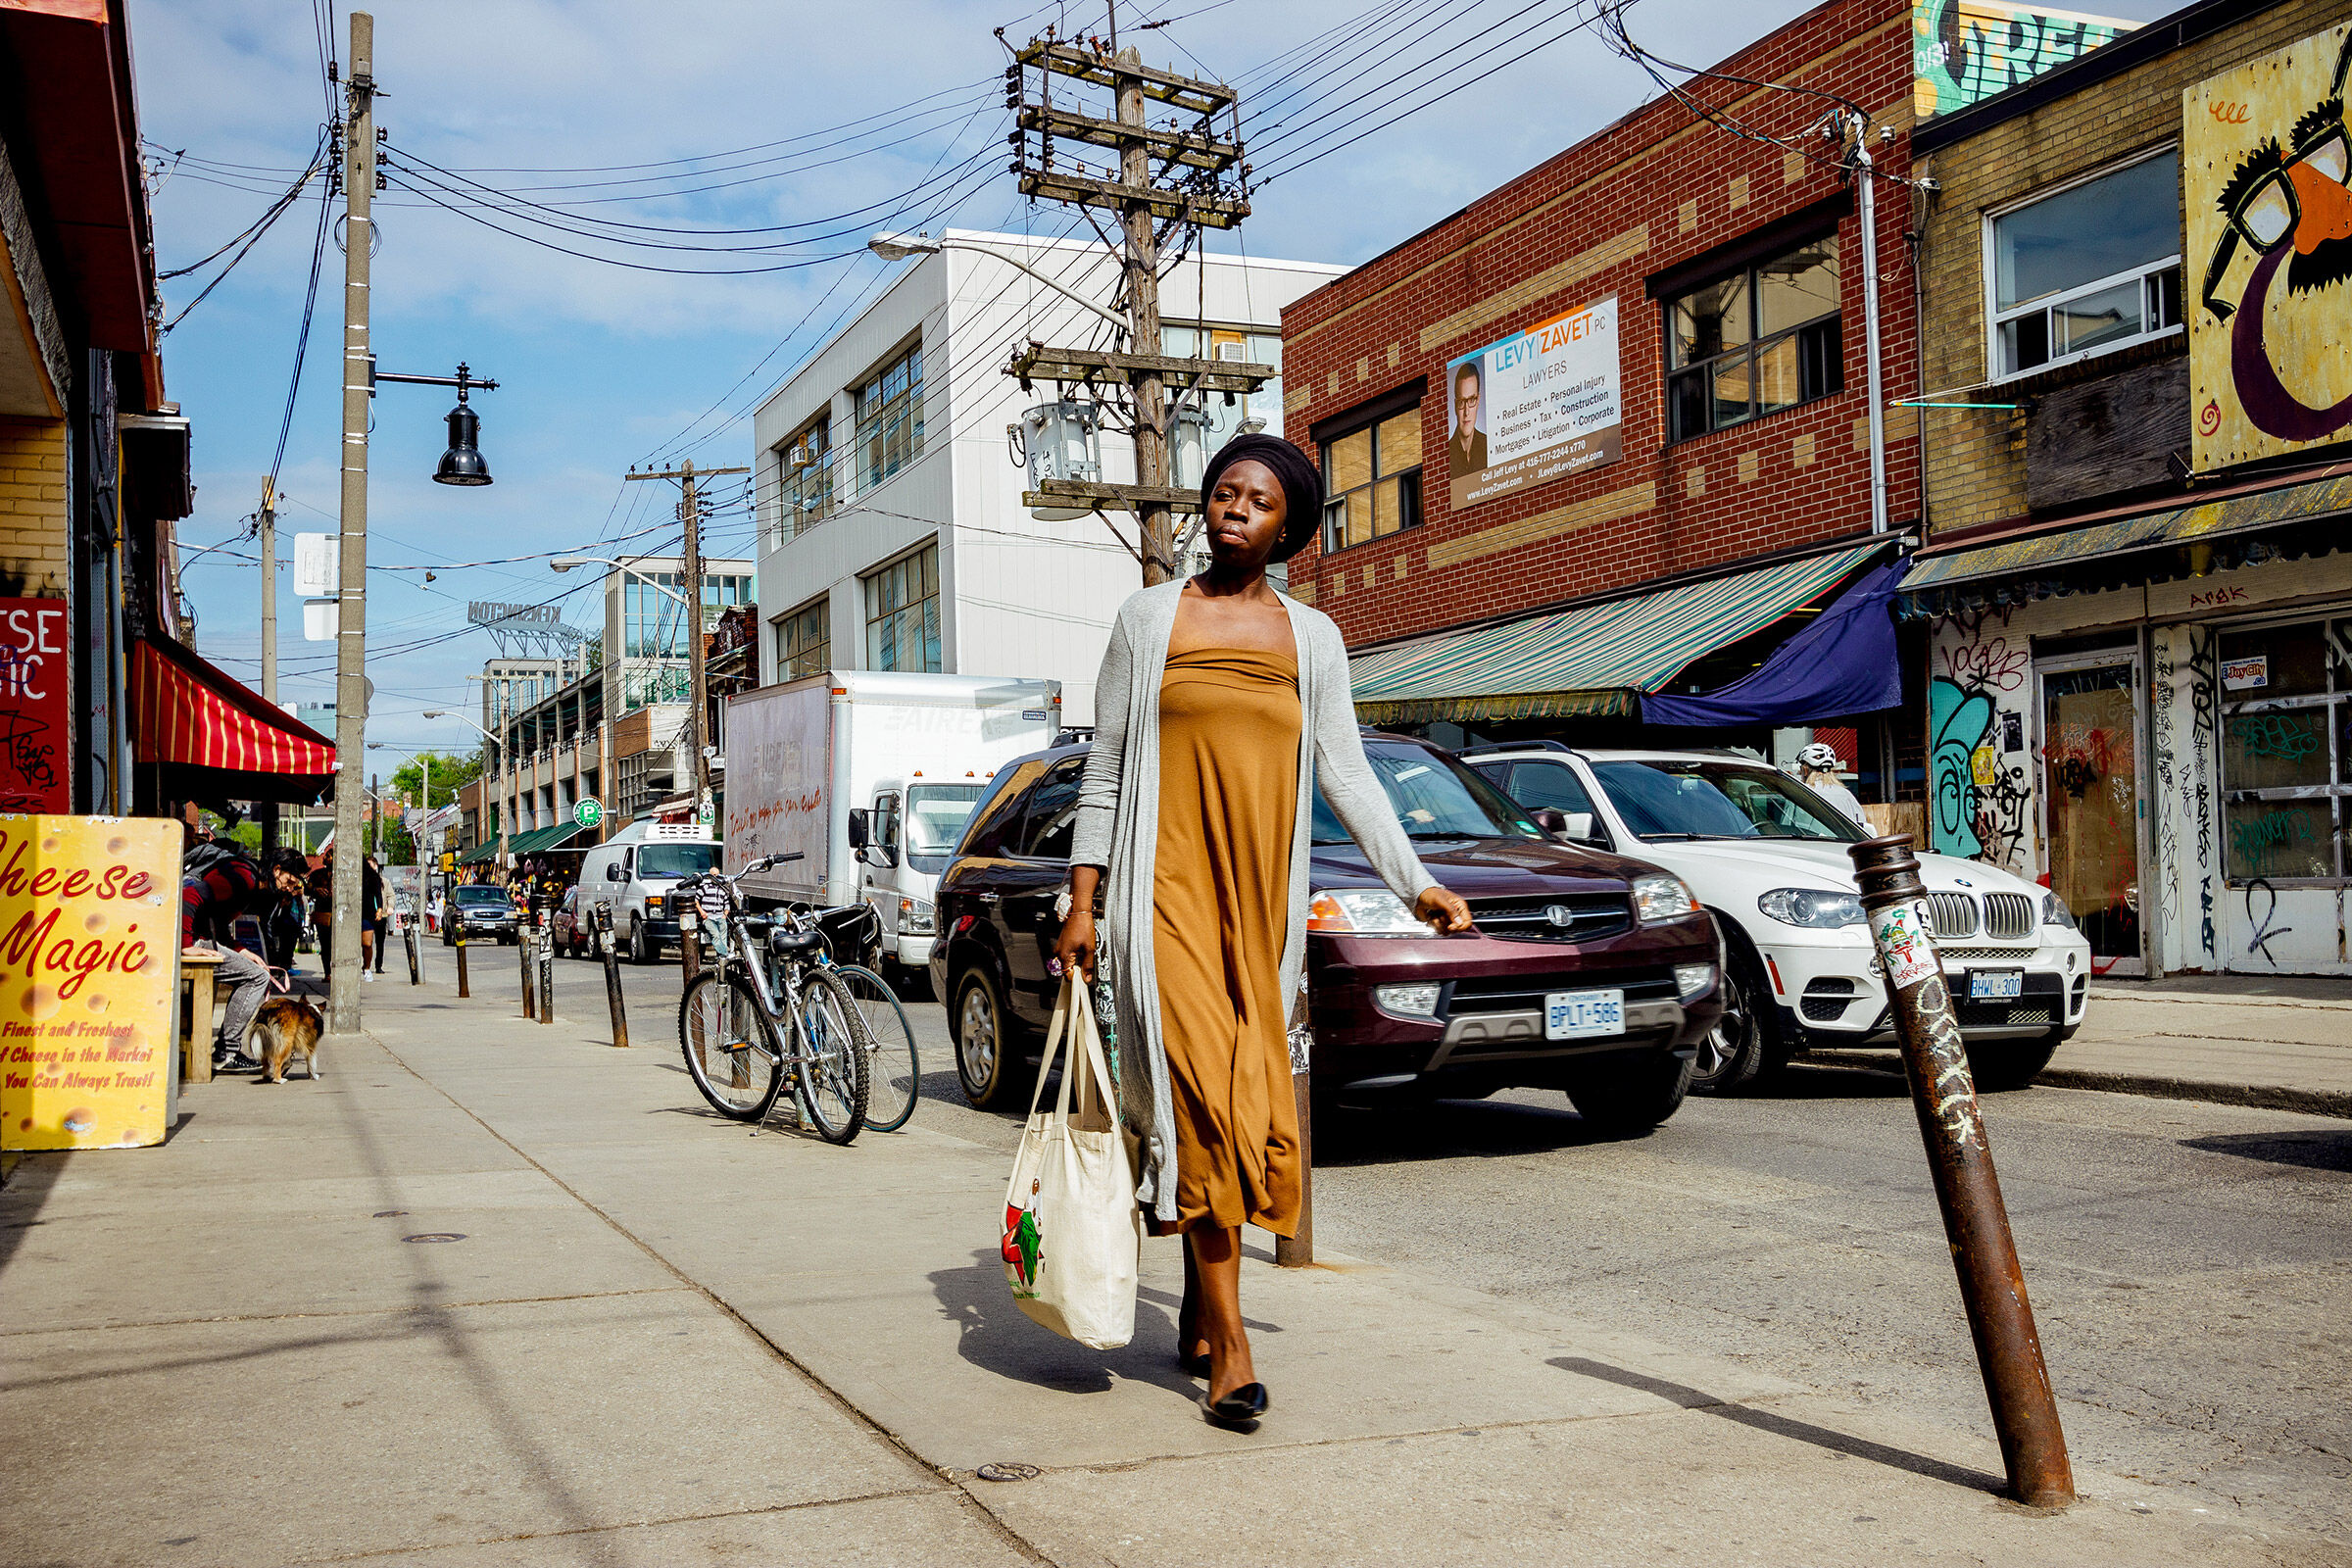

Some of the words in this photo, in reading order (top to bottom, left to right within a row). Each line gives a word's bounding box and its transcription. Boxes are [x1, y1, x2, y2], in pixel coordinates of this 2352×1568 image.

[1495, 336, 1536, 372] LEVY
[1540, 312, 1593, 355] ZAVET
[1594, 316, 1606, 332] PC
[1522, 360, 1568, 389] LAWYERS
[1500, 418, 1532, 437] Business
[1540, 412, 1552, 422] Tax
[1560, 391, 1609, 416] Construction
[1502, 406, 1518, 420] Real
[1519, 399, 1542, 415] Estate
[1550, 383, 1582, 403] Personal
[1584, 374, 1606, 391] Injury
[1494, 436, 1530, 455] Mortgages
[1538, 421, 1570, 441] Litigation
[1578, 406, 1615, 426] Corporate
[1481, 470, 1493, 482] Call
[1493, 466, 1504, 479] Jeff
[1504, 464, 1518, 475] Levy
[1518, 462, 1525, 470] at
[0, 610, 63, 654] SE
[0, 655, 46, 700] IC
[583, 806, 595, 819] P
[0, 907, 149, 1000] Magic
[1, 1021, 46, 1037] Finest
[48, 1020, 75, 1037] and
[76, 1020, 134, 1037] Freshest
[10, 1046, 58, 1063] Cheese
[61, 1047, 75, 1062] in
[79, 1046, 101, 1062] the
[105, 1046, 154, 1062] Market
[5, 1071, 29, 1089] You
[32, 1072, 59, 1089] Can
[62, 1071, 111, 1093] Always
[115, 1071, 155, 1089] Trust!
